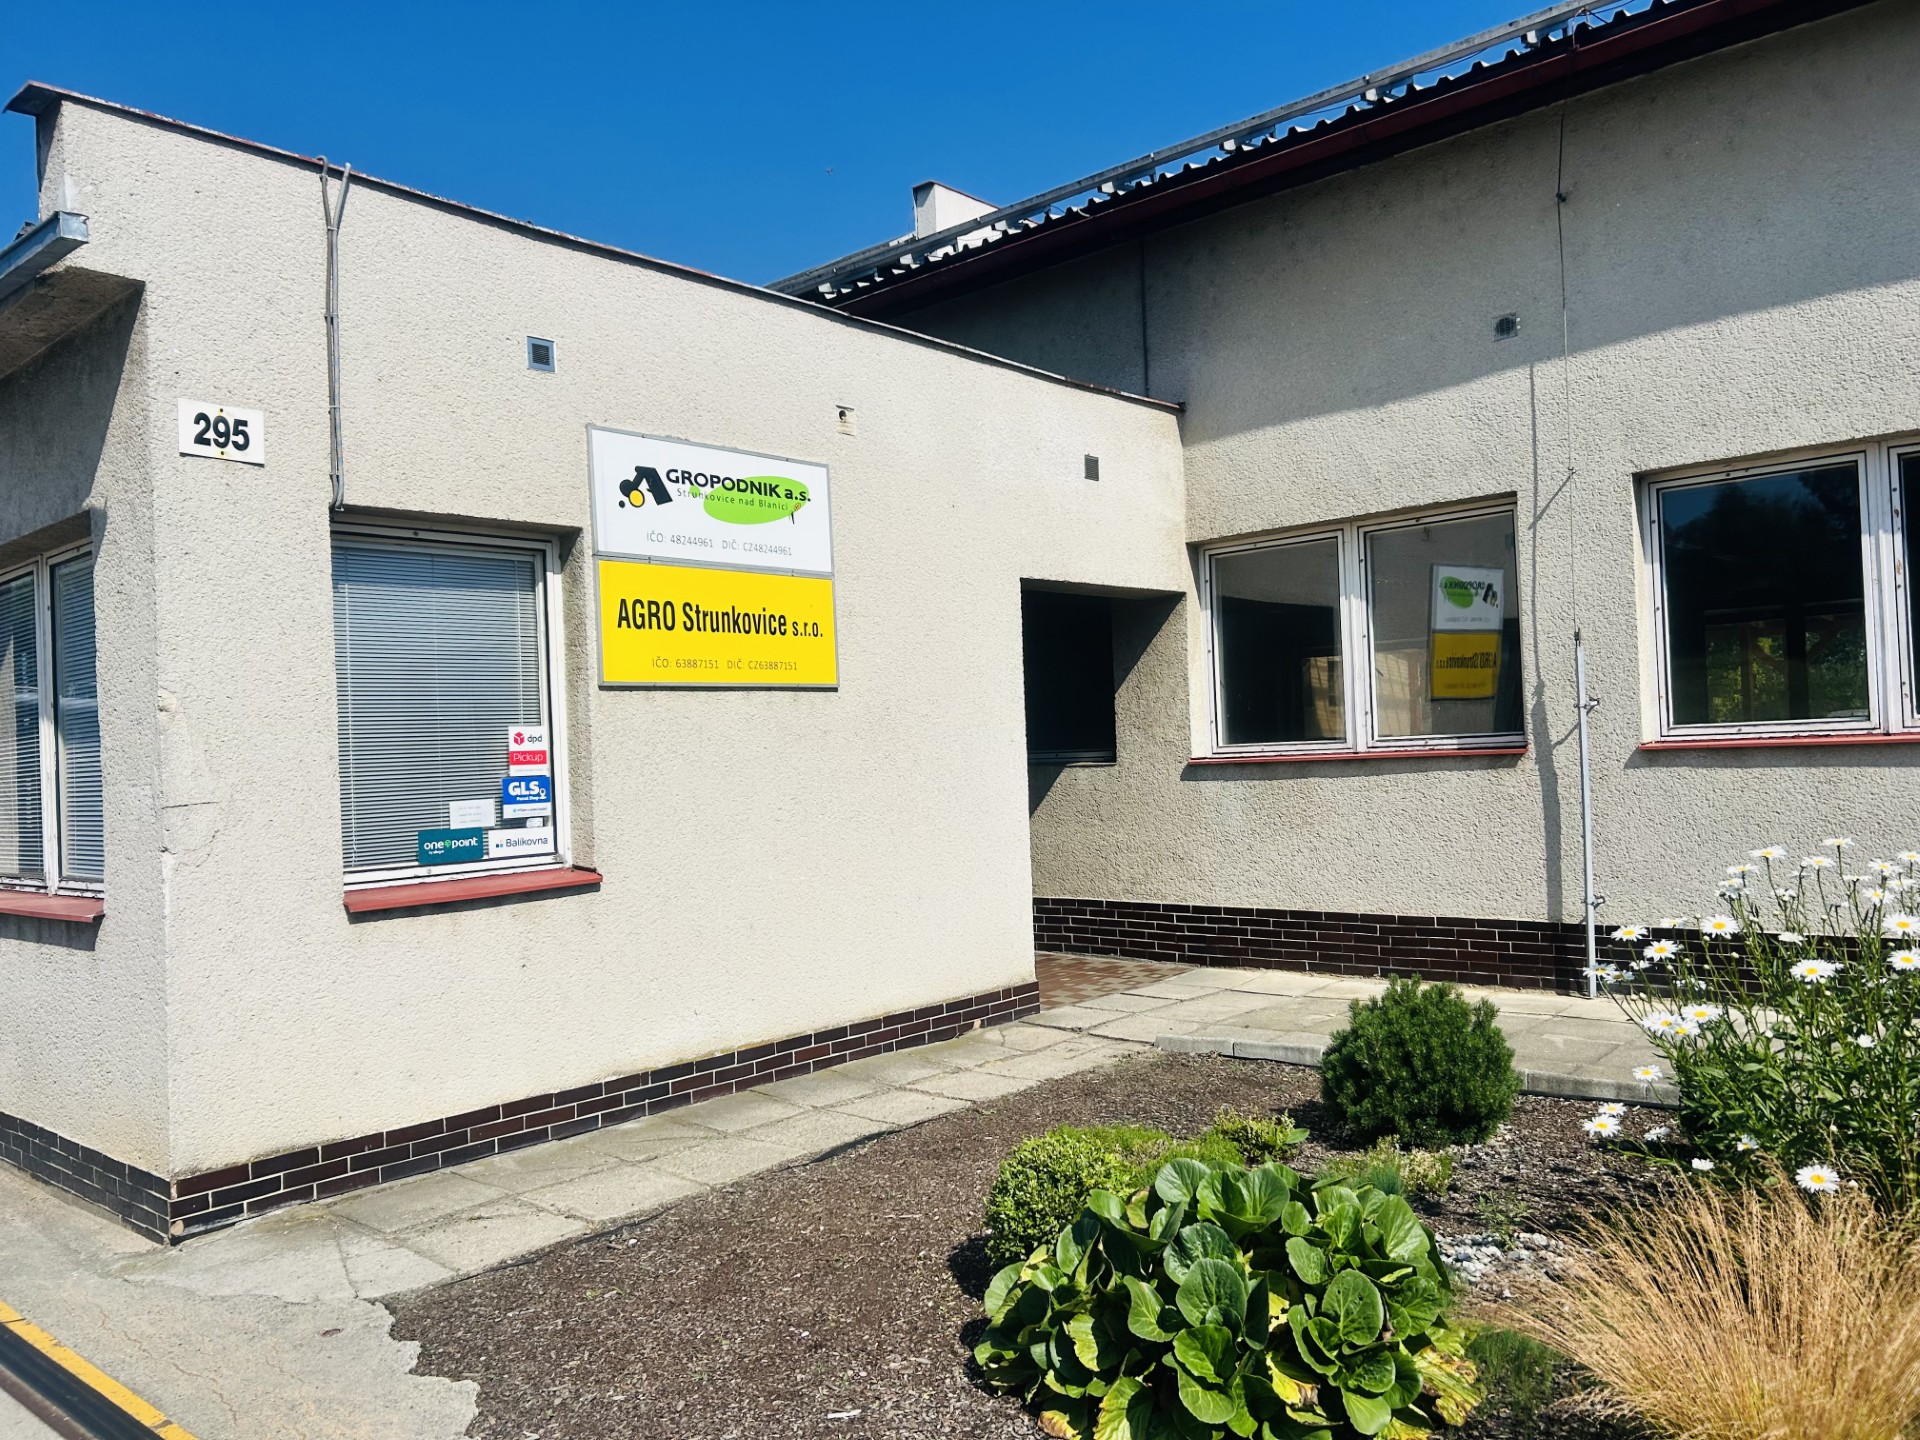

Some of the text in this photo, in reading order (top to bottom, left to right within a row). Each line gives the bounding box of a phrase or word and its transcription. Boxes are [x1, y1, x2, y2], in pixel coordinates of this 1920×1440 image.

[193, 411, 250, 452] 295
[676, 487, 736, 504] Strunkovice
[738, 497, 755, 507] nad
[784, 488, 812, 502] a.s.
[646, 530, 793, 556] IČO: 48244961 DIČ: CZ48244961
[617, 598, 823, 638] AGRO Strunkovice s.r.o.
[652, 655, 798, 671] IČO: 63887151 DIČ: CZ63887151
[527, 735, 542, 744] dpd
[513, 752, 544, 763] Pickup
[508, 780, 540, 796] GLS
